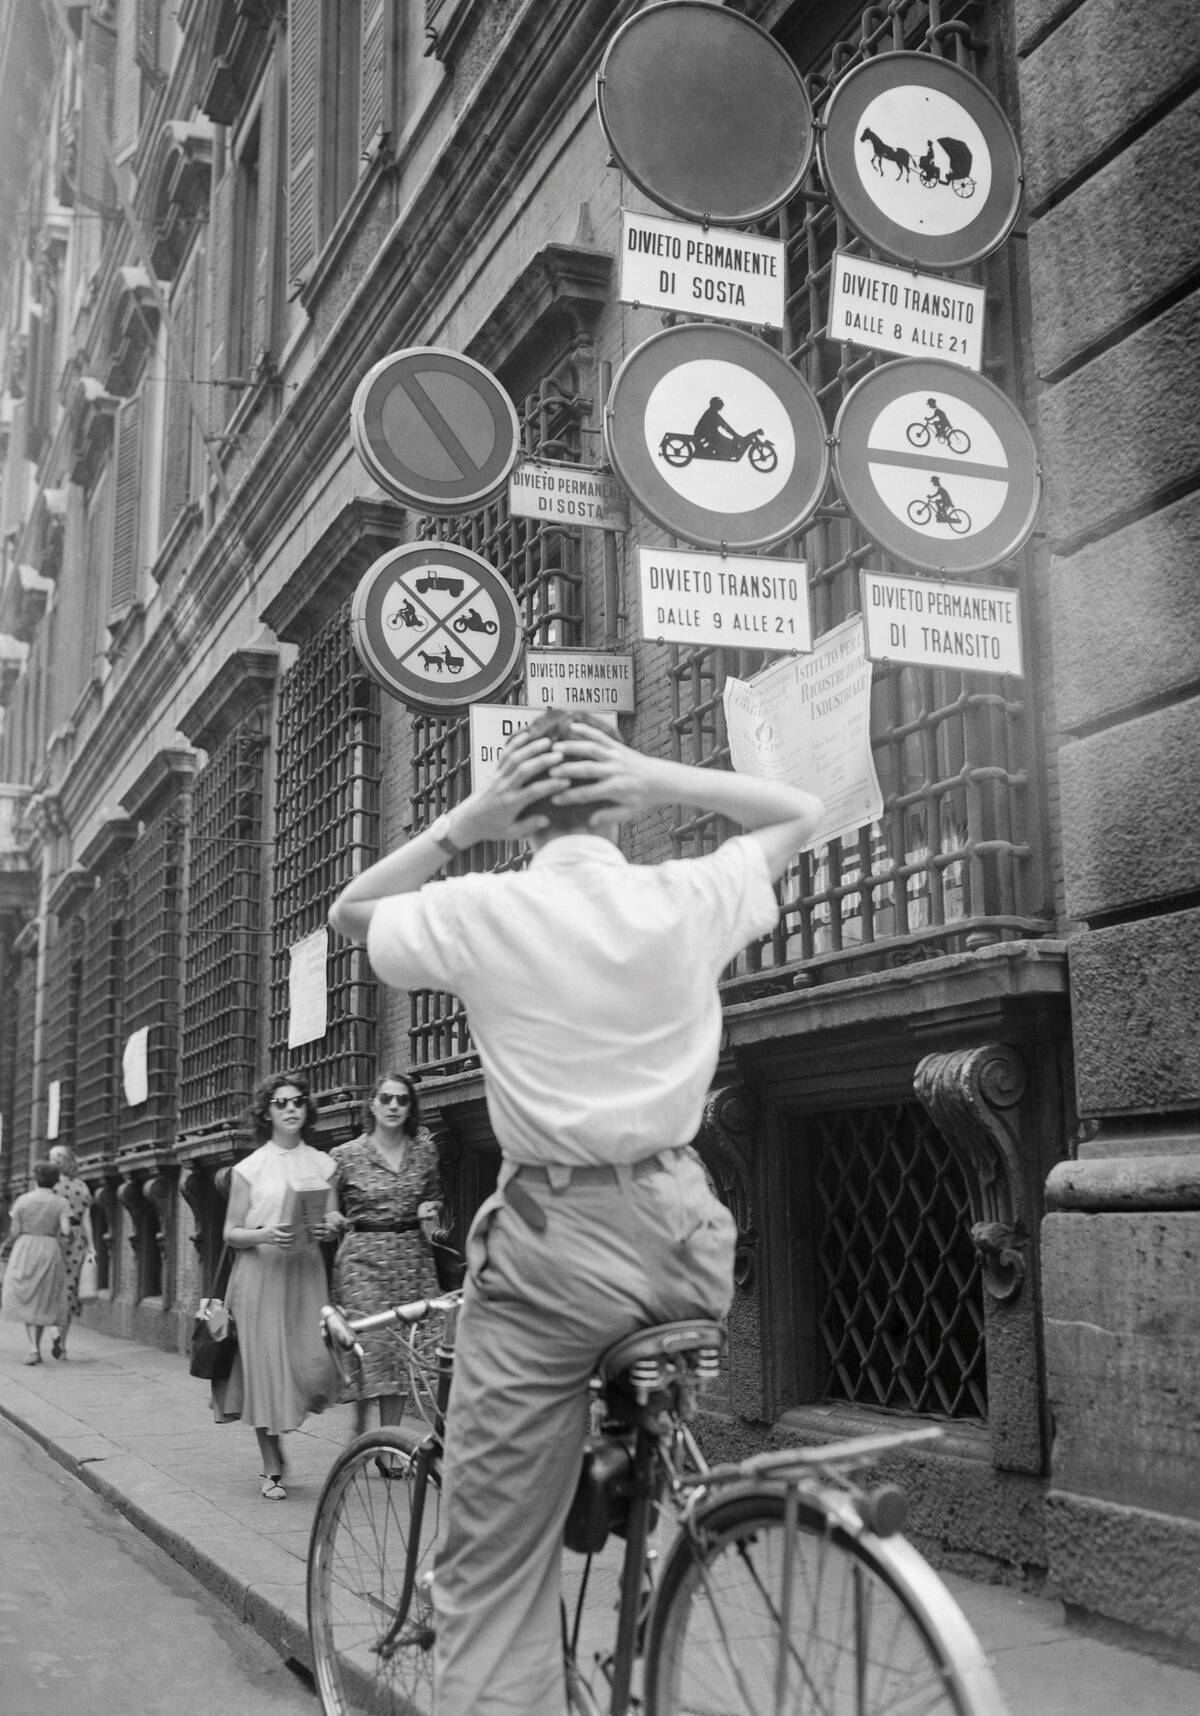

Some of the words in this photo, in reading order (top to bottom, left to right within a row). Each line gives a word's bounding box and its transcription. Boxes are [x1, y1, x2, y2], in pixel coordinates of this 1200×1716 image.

[628, 227, 681, 260] DIVIETO
[686, 240, 778, 279] PERMANENTE
[659, 270, 676, 295] DI
[692, 277, 746, 307] SOSTA
[842, 272, 898, 306] DIVIETO
[904, 287, 975, 325] TRANSITO
[845, 310, 884, 335] DALLE
[893, 323, 903, 340] 8
[911, 326, 944, 350] ALLE
[949, 336, 968, 354] 21
[513, 471, 555, 491] DIVIETO
[538, 496, 553, 512] DI
[557, 499, 605, 519] SOSTA
[649, 567, 712, 595] DIVIETO
[718, 573, 798, 602] TRANSITO
[657, 607, 700, 628] DALLE
[713, 613, 723, 630] 9
[733, 614, 768, 633] ALLE
[775, 617, 795, 634] 21
[872, 584, 924, 614] DIVIETO
[928, 591, 1013, 625] PERMANENTE
[890, 623, 907, 649] DI
[921, 627, 1001, 661] TRANSITO
[529, 663, 566, 679] DIVIETO
[569, 664, 630, 681] PERMANENTE
[794, 648, 839, 684] ISTITUTO
[541, 685, 555, 703] DI
[565, 687, 618, 704] TRANSITO
